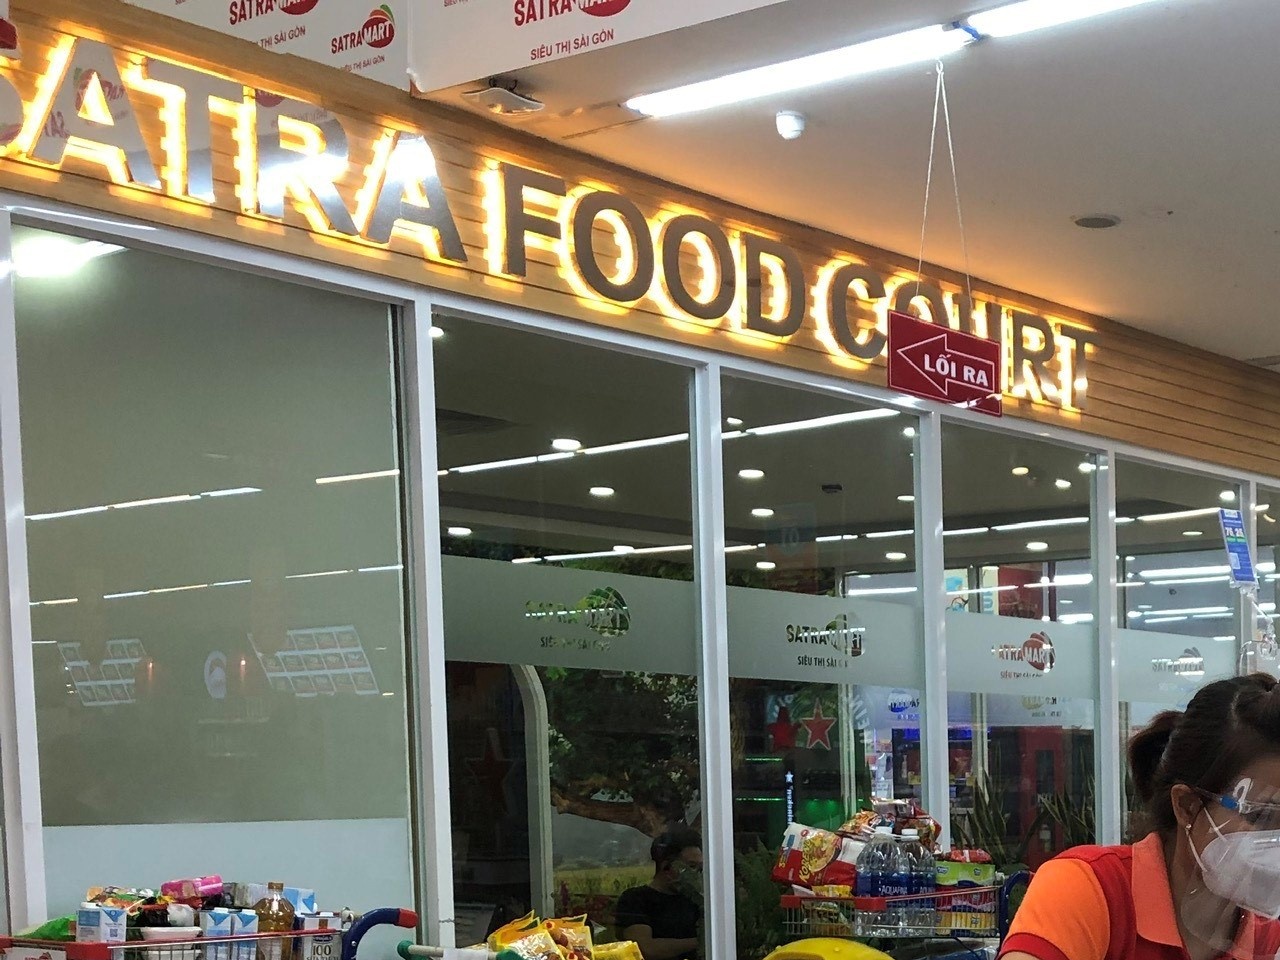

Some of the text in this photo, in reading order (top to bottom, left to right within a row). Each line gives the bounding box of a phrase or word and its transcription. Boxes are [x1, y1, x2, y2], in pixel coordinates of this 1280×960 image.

[331, 21, 392, 54] SATRAMART
[530, 28, 614, 60] SIÊU THỊ SÀI GÒN
[502, 165, 805, 337] FOOD
[924, 353, 989, 387] LỐI RA
